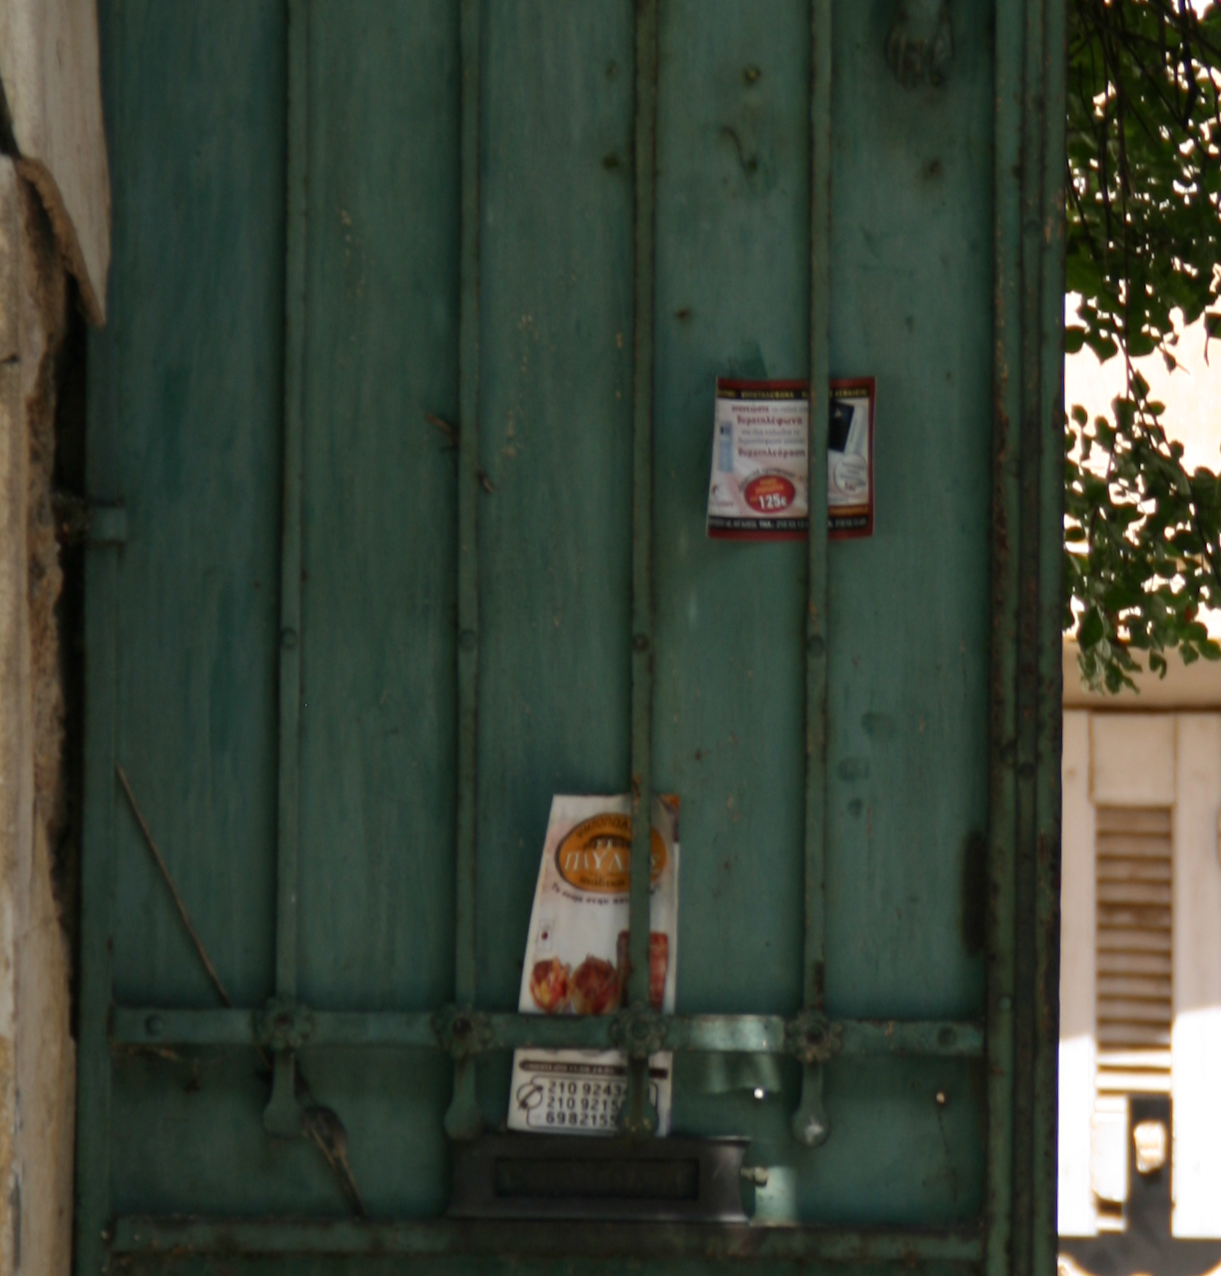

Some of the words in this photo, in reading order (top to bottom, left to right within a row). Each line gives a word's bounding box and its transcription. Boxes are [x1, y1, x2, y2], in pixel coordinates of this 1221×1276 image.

[547, 1080, 577, 1095] 210
[582, 1082, 626, 1097] 9243
[546, 1095, 575, 1110] 210
[580, 1097, 620, 1112] 9215
